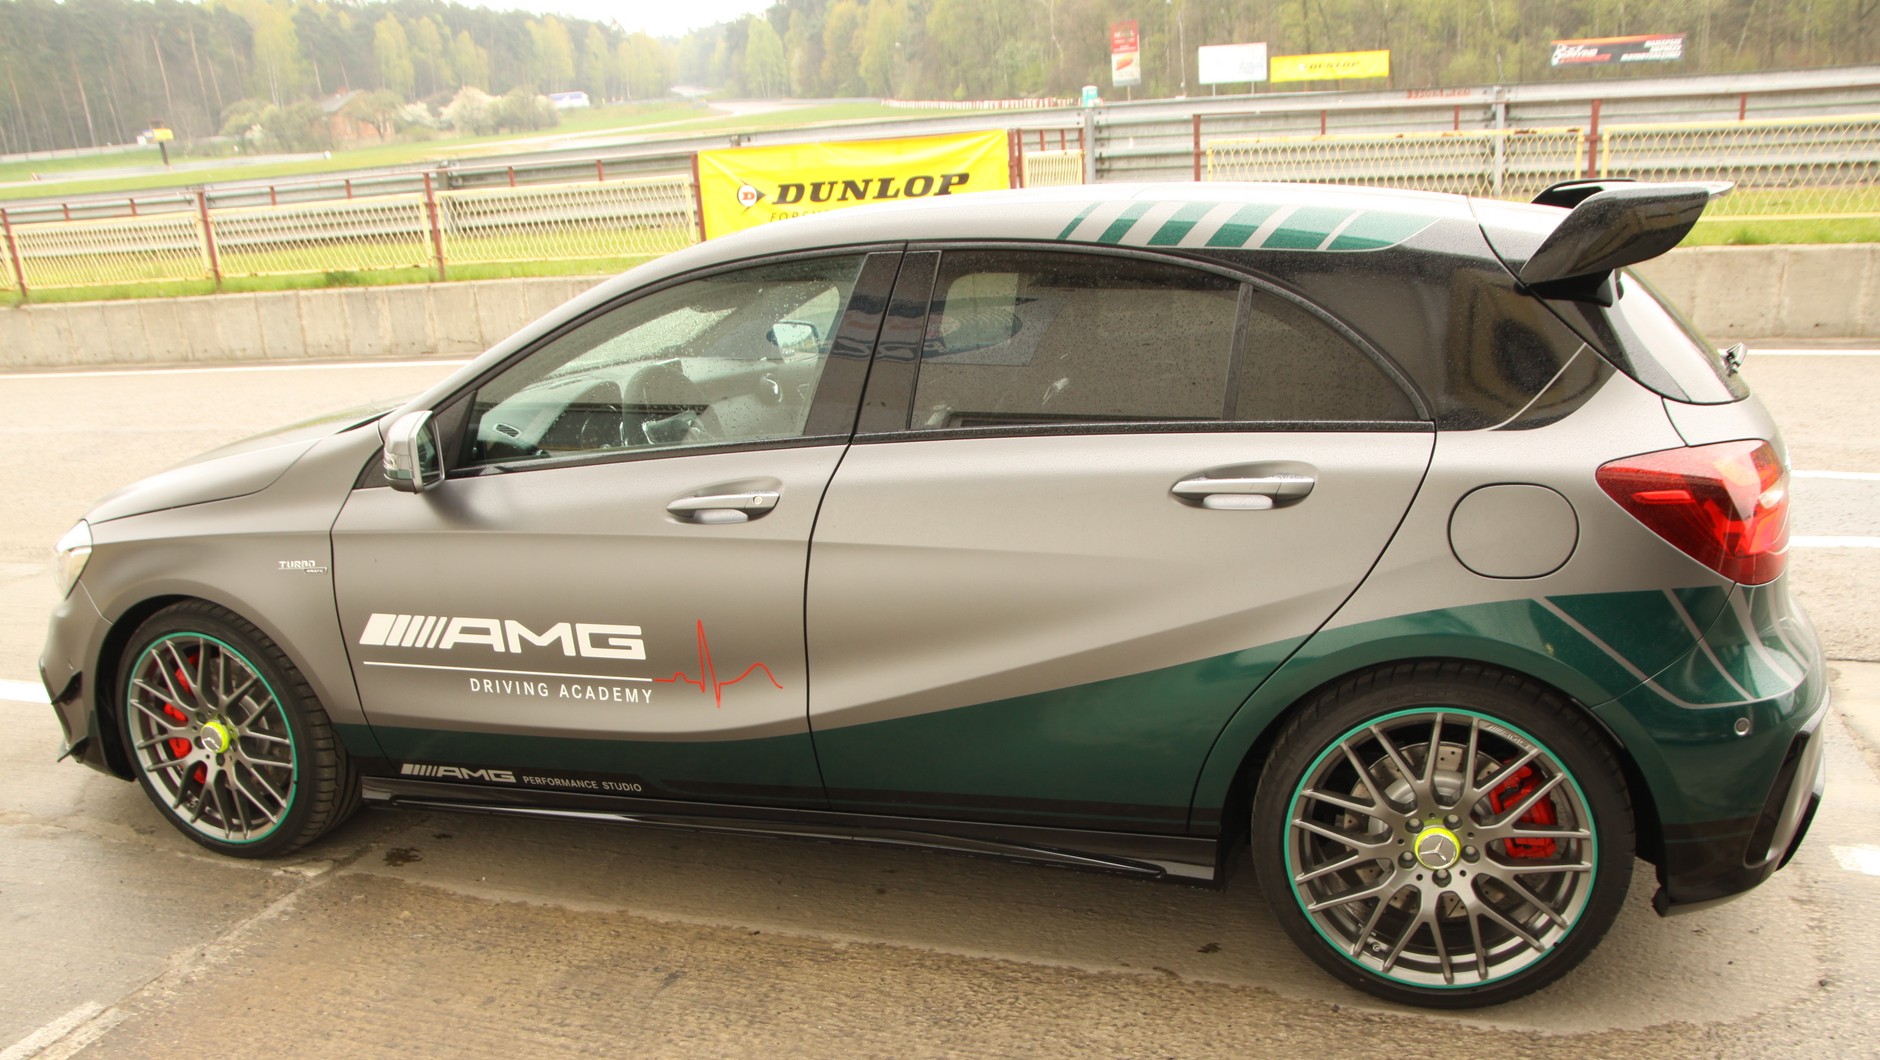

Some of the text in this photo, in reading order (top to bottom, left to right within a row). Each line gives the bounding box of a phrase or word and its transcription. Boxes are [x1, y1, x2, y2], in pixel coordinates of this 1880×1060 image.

[772, 172, 970, 205] DUNLOP
[438, 616, 647, 660] AMG
[469, 677, 653, 704] DRIVING ACADEMY
[436, 766, 643, 793] AMG PERFORMANCE STUDIO
